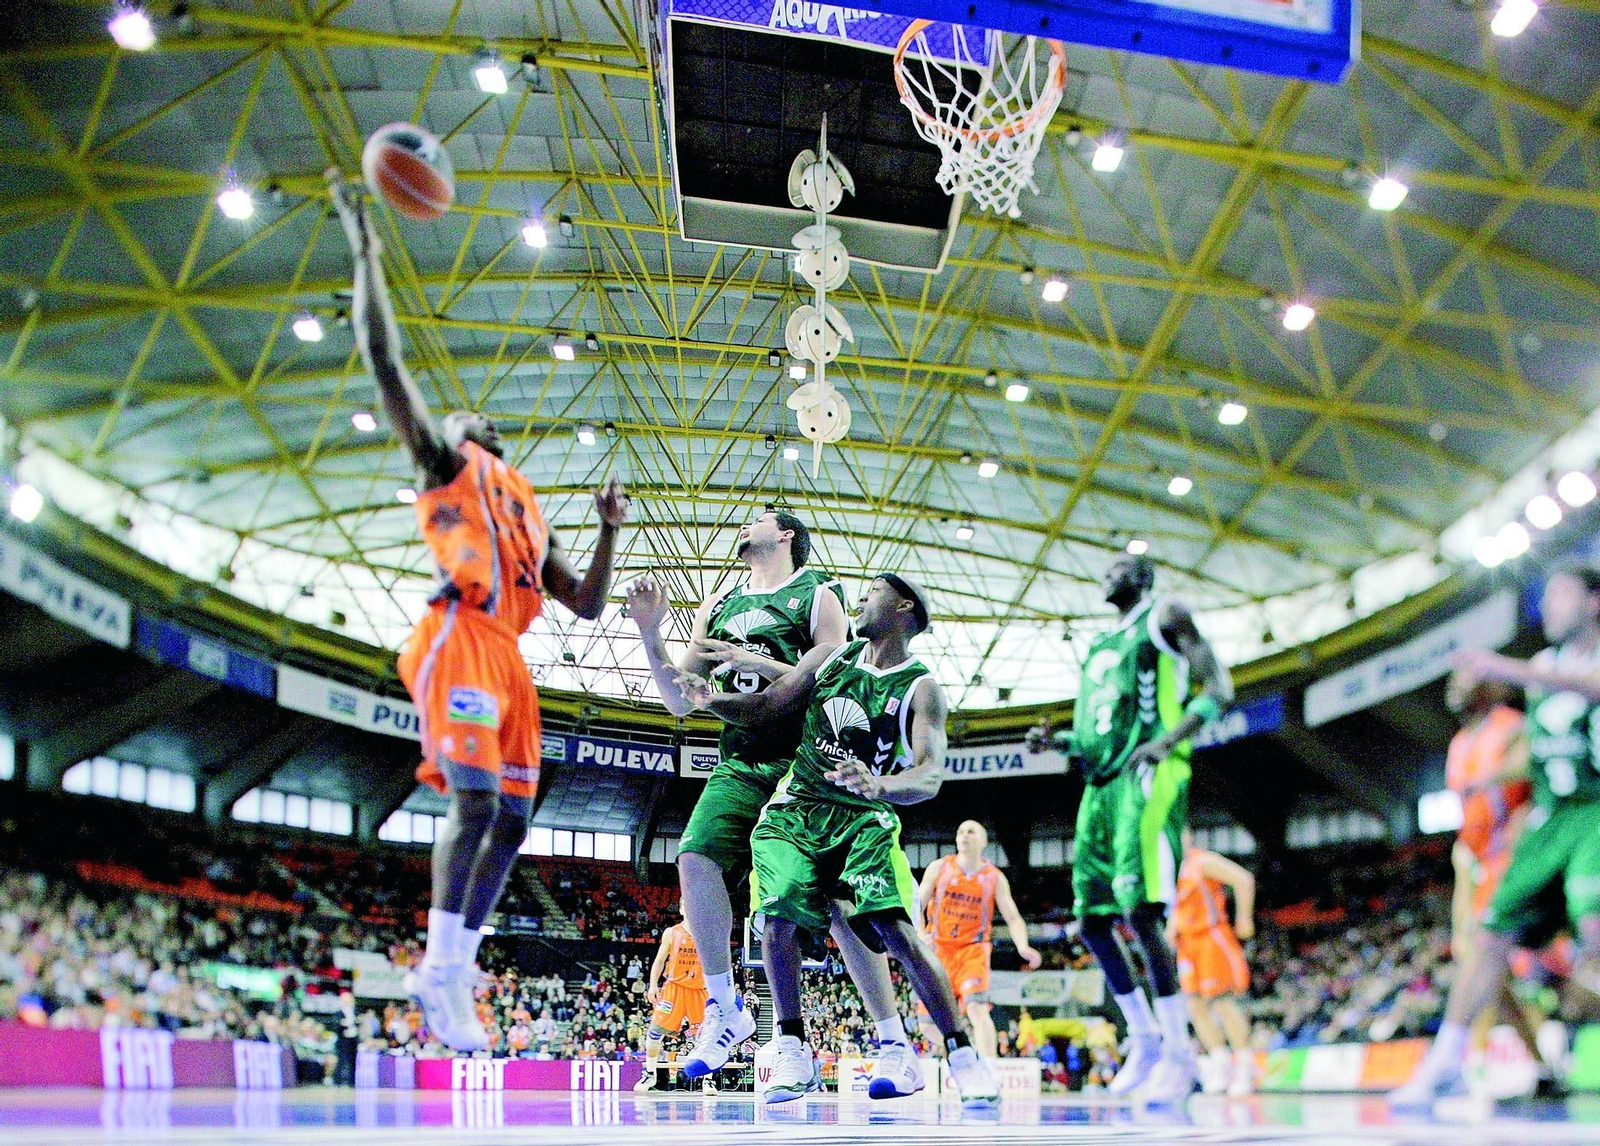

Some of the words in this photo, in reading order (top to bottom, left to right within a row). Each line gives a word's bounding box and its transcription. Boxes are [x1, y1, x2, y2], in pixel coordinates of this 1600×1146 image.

[576, 740, 675, 772] PULEVA
[692, 755, 718, 763] PULEVA
[100, 1025, 175, 1090] FIAT
[232, 1039, 283, 1090] FIAT
[451, 1058, 508, 1090] FIAT
[571, 1060, 625, 1091] FIAT
